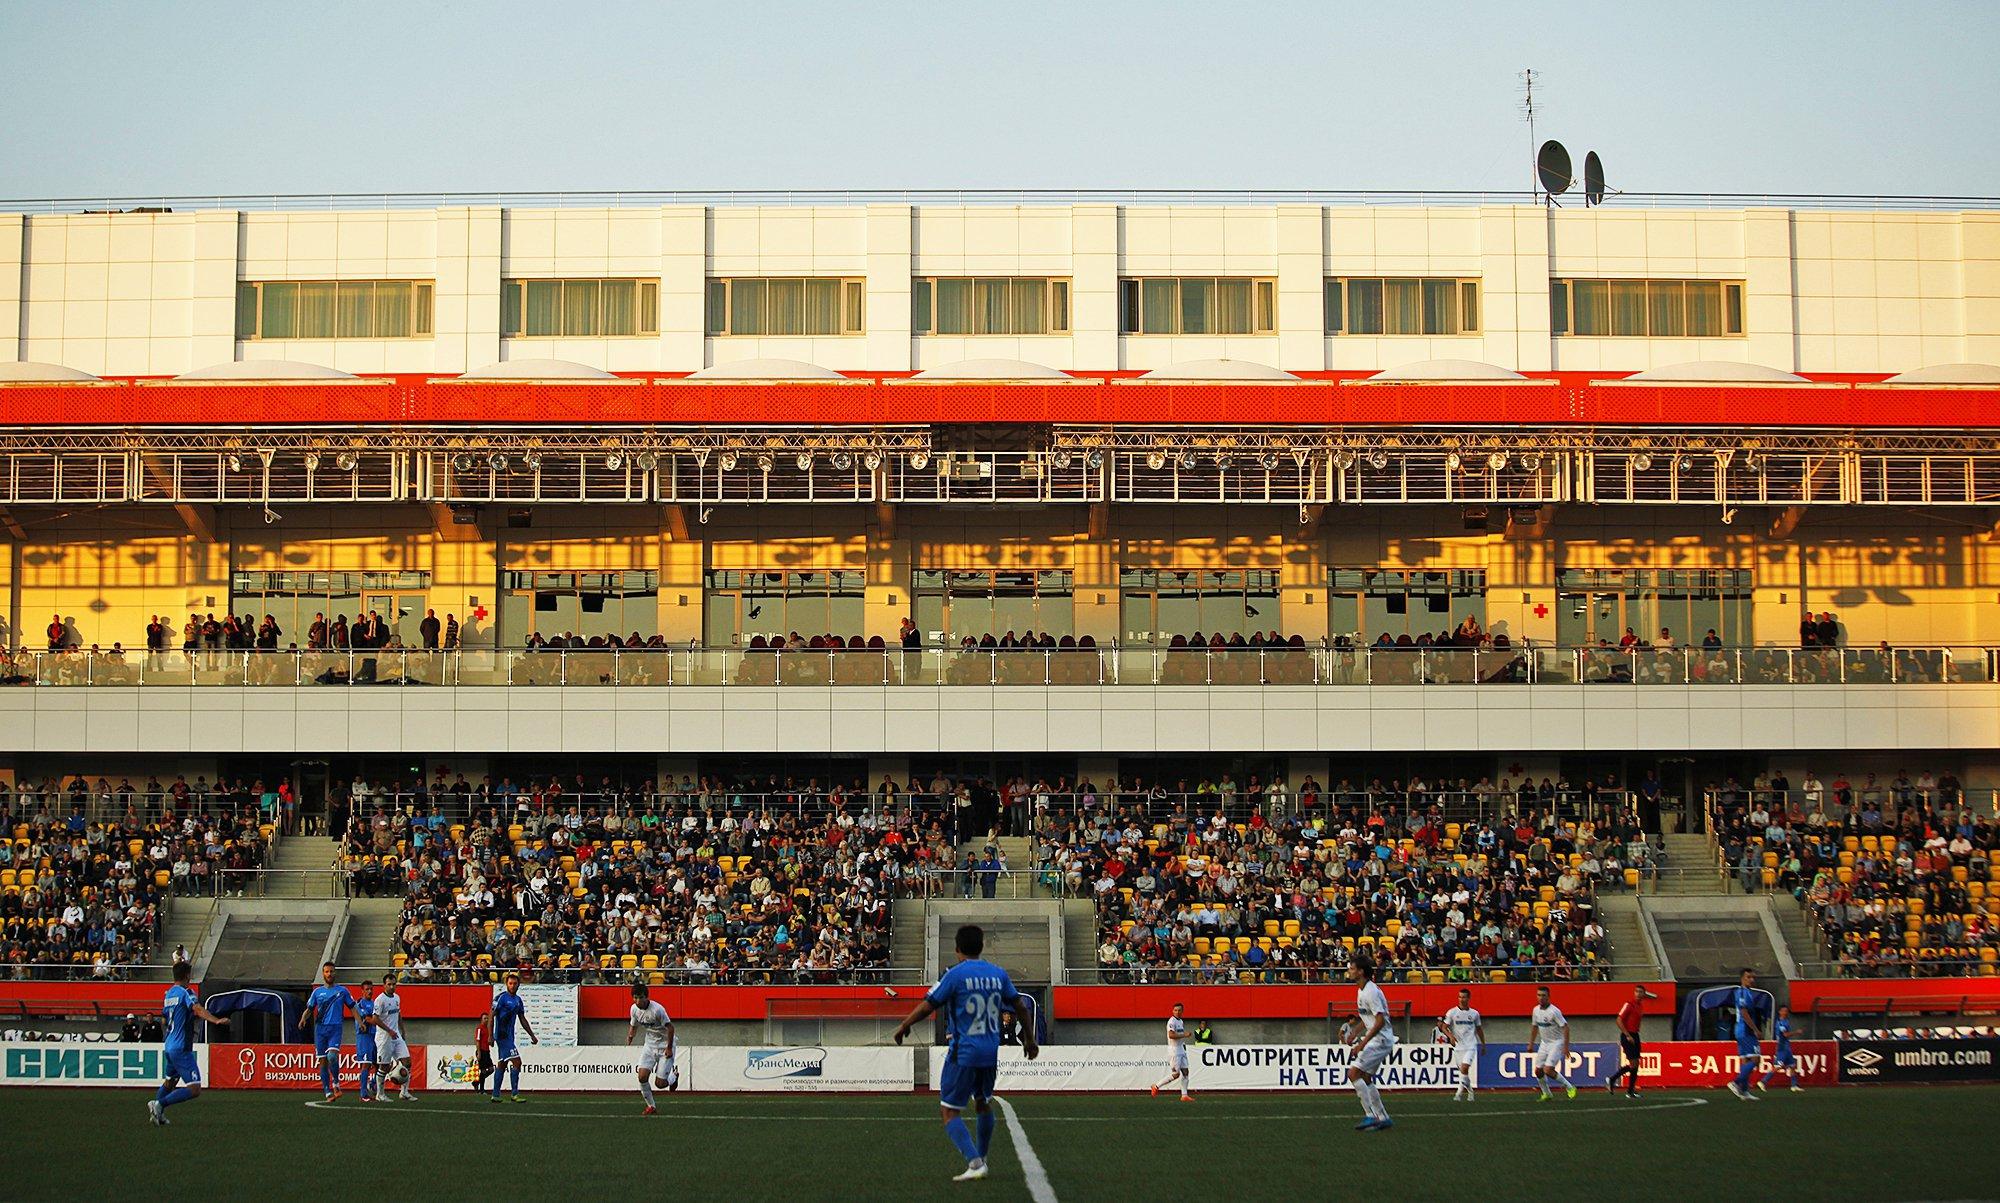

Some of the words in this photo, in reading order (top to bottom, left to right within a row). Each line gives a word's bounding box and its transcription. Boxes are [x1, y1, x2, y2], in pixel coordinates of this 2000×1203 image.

[7, 1049, 198, 1079] СИБУ
[264, 1053, 361, 1070] КОМПАИЯ
[750, 1057, 822, 1071] ТрансМедиа
[1201, 1048, 1319, 1067] СМОТРИТЕ
[1326, 1047, 1403, 1066] МАИ
[1498, 1051, 1602, 1079] СПРТ
[1689, 1055, 1720, 1074] ЗА
[1724, 1054, 1828, 1078] ПБДУ!
[1894, 1047, 1992, 1067] umbro.com
[265, 1072, 322, 1081] ВИЗУАЛЬНЫ
[573, 1062, 632, 1074] ТЮМЕНСКОЙ
[1279, 1068, 1309, 1086] НА
[1315, 1066, 1460, 1086] ТЕЛКАНАЛЕ
[1847, 1067, 1880, 1075] umbro
